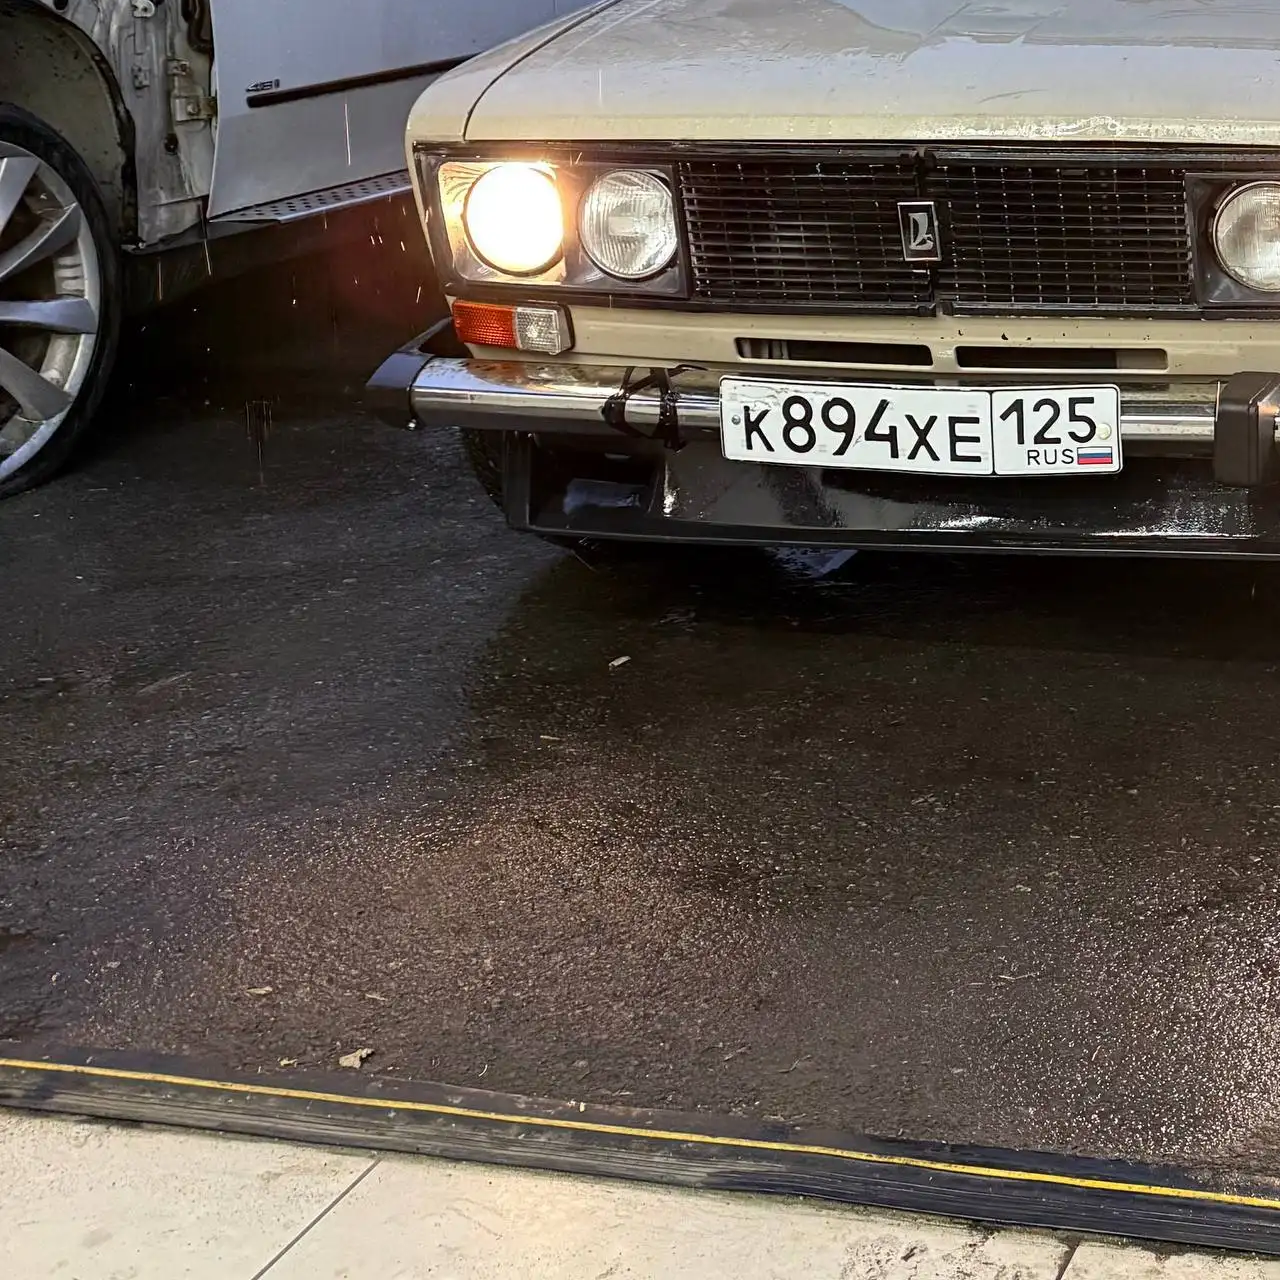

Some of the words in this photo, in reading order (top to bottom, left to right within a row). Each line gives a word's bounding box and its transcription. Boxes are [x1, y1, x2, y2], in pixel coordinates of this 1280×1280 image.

[743, 395, 983, 464] К894ХЕ
[999, 396, 1096, 445] 125
[1027, 447, 1074, 465] RUS
